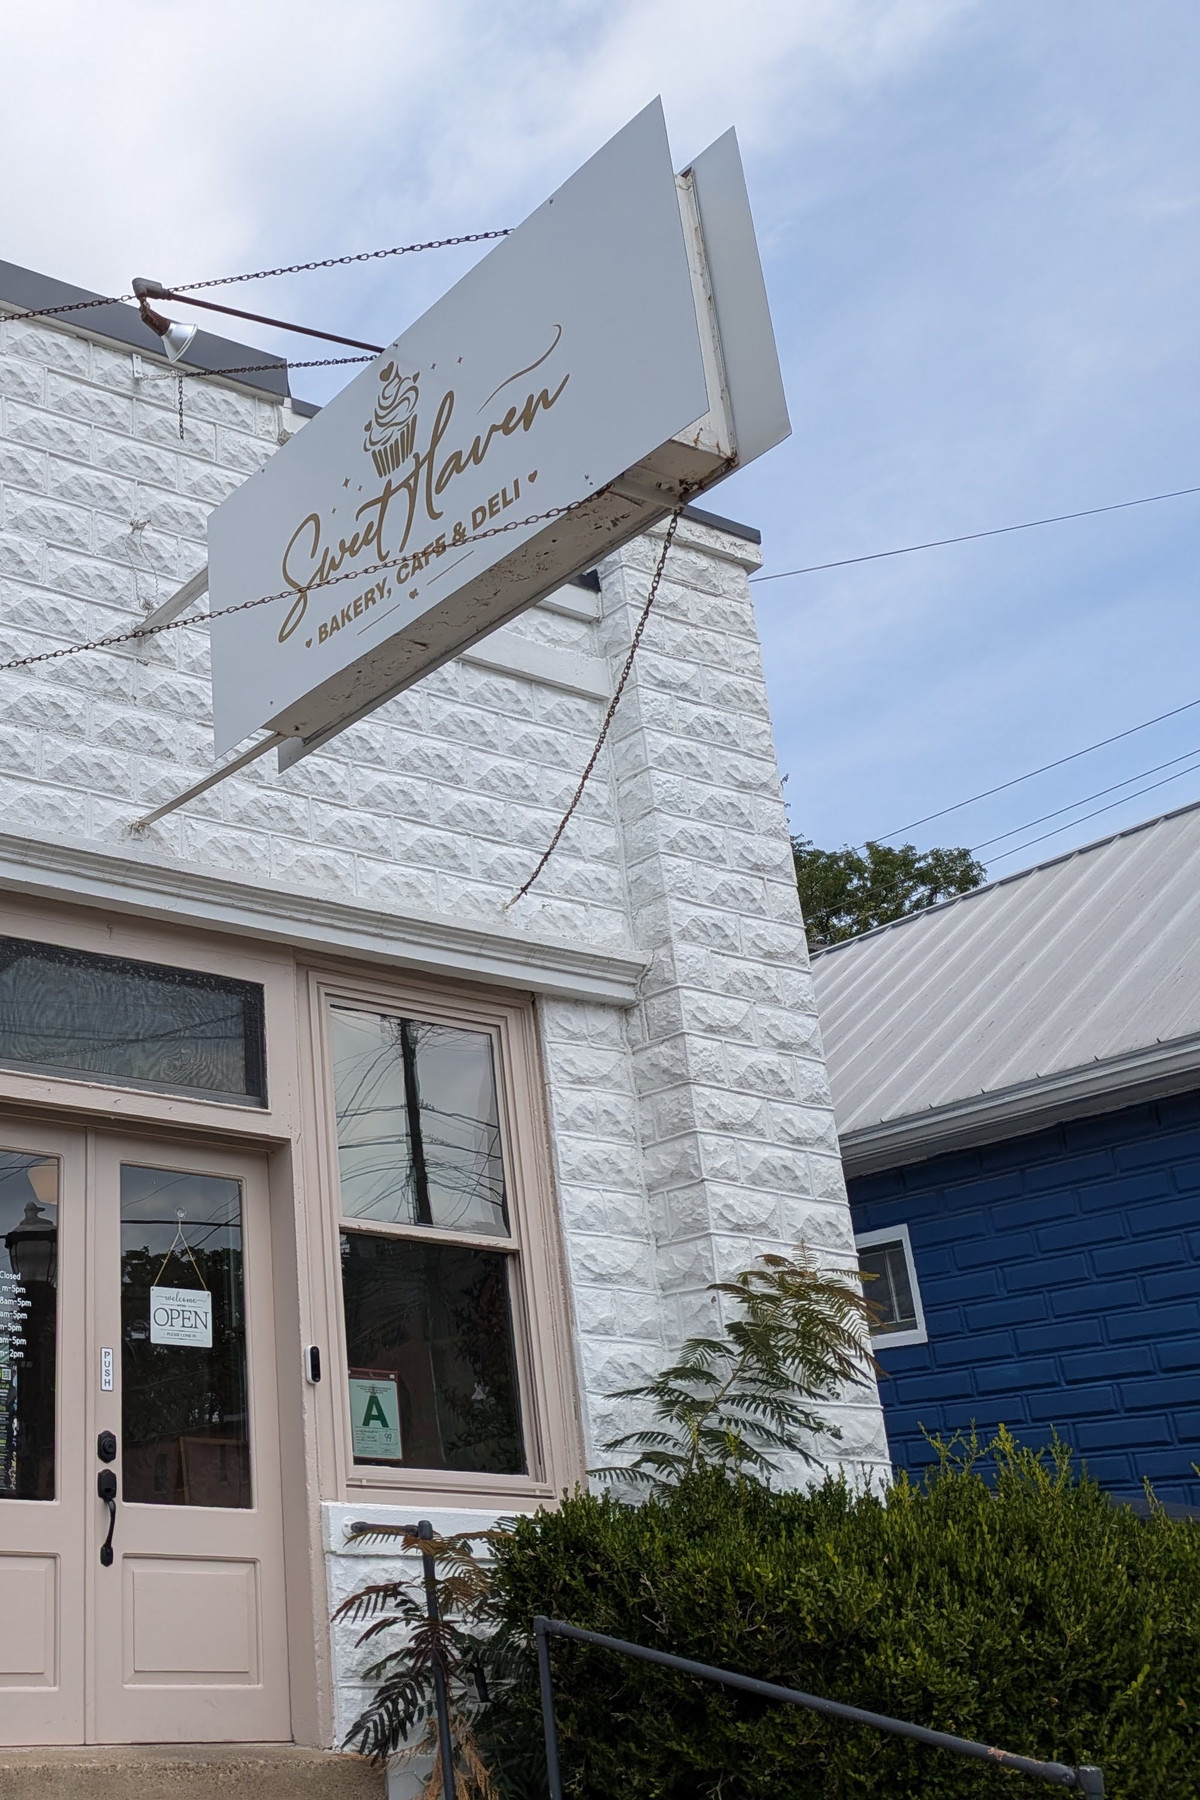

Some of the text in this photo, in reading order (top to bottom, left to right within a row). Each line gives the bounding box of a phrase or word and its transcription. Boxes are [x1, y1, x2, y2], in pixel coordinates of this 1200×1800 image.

[278, 373, 571, 643] Sweet Haven
[318, 576, 392, 645] BAKERY,
[452, 521, 467, 544] &
[471, 477, 521, 531] DELI
[0, 1296, 32, 1308] 8am-5pm
[158, 1291, 204, 1304] welcome
[153, 1307, 210, 1330] OPEN
[362, 1395, 390, 1428] A
